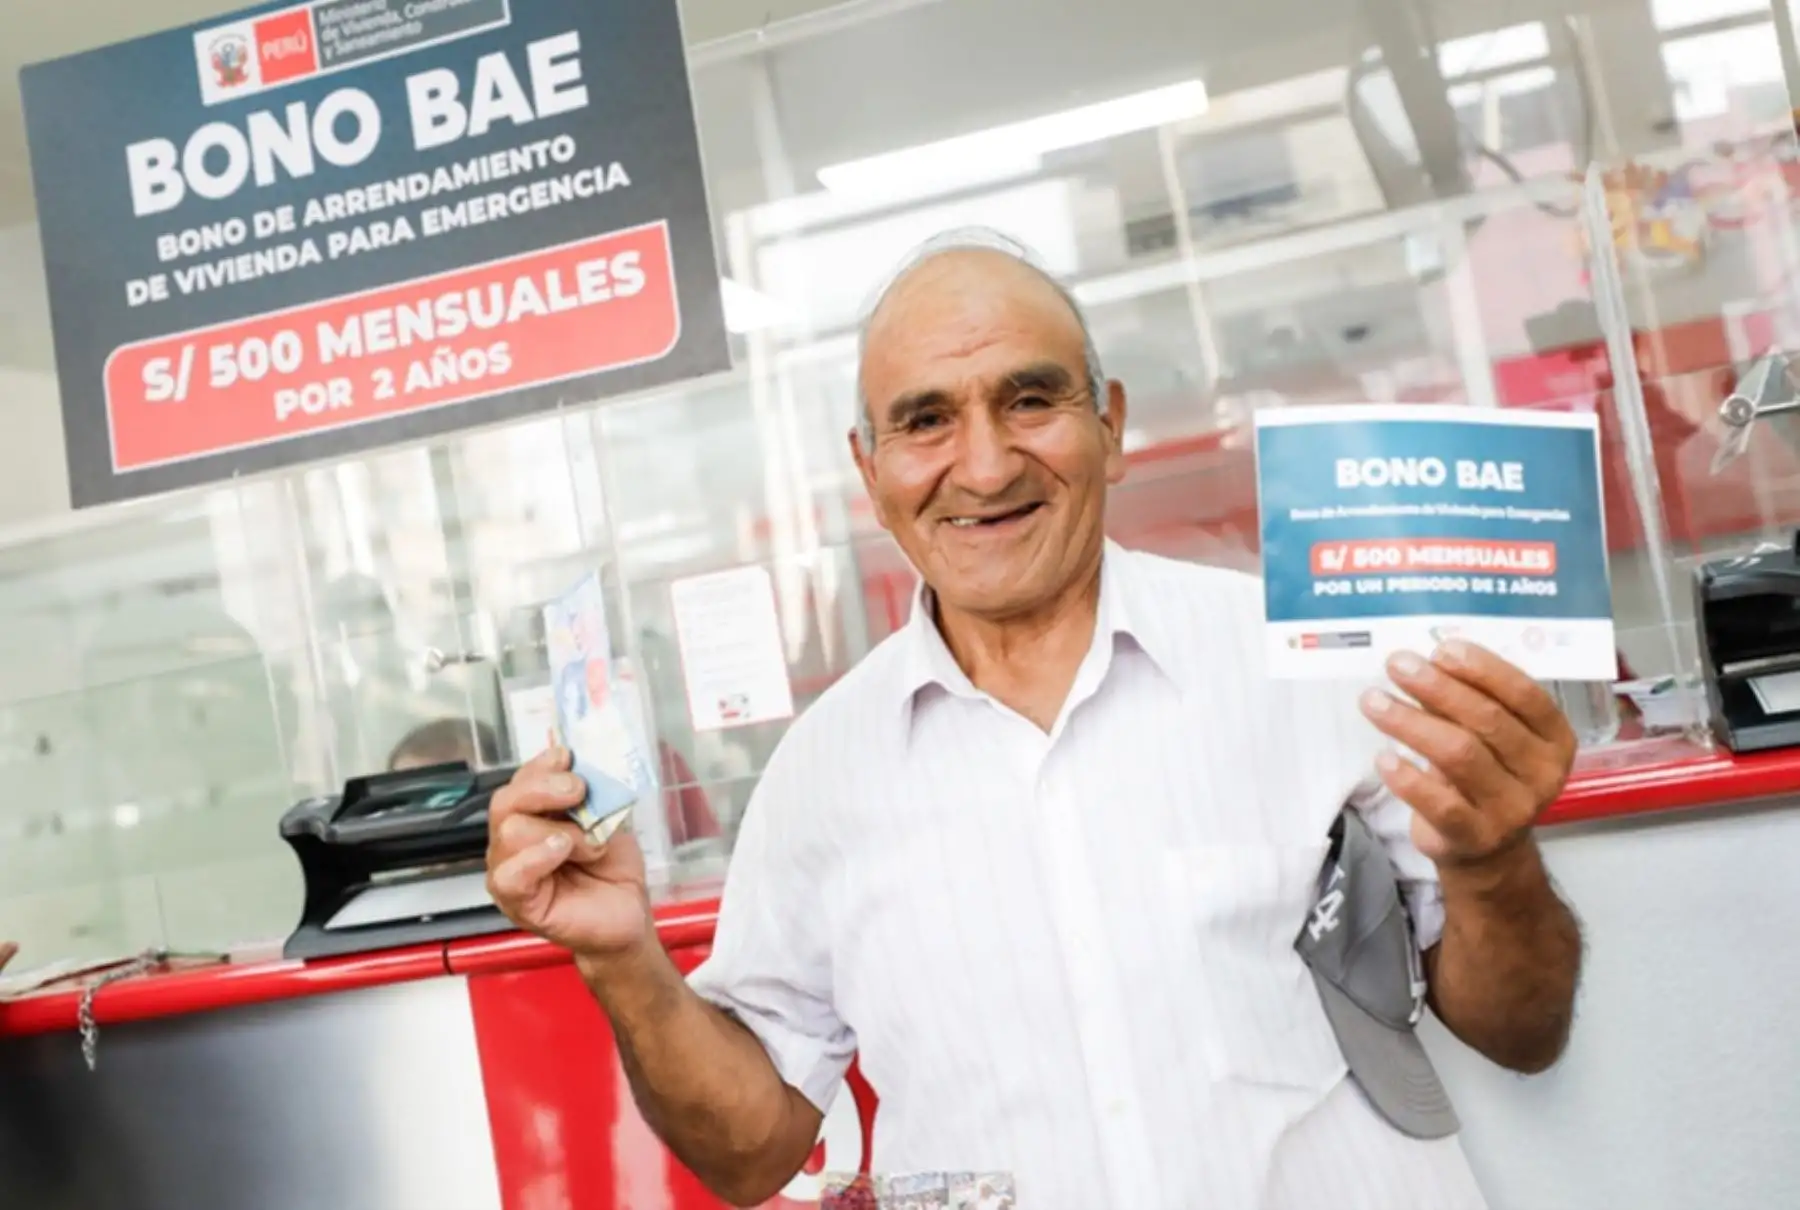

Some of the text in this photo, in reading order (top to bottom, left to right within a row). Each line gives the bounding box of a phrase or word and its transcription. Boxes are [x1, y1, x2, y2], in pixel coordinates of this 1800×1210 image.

[262, 31, 307, 60] PERÚ
[321, 26, 340, 43] de
[127, 31, 589, 217] BONO BAE
[157, 134, 576, 262] BONO DE ARRENDAMIENTO
[126, 161, 631, 307] DE VIVIENDA PARA EMERGENCIA
[142, 250, 647, 401] S/ 500 MENSUALES
[274, 341, 513, 421] POR 2 AÑOS
[1335, 457, 1524, 490] BONO BAE
[1314, 581, 1352, 596] POR
[1356, 578, 1383, 594] UN
[1386, 577, 1468, 592] PERIODO
[1470, 579, 1494, 593] DE
[1510, 576, 1558, 596] AÑOS
[1320, 545, 1551, 571] S/ 500 MENSUALES
